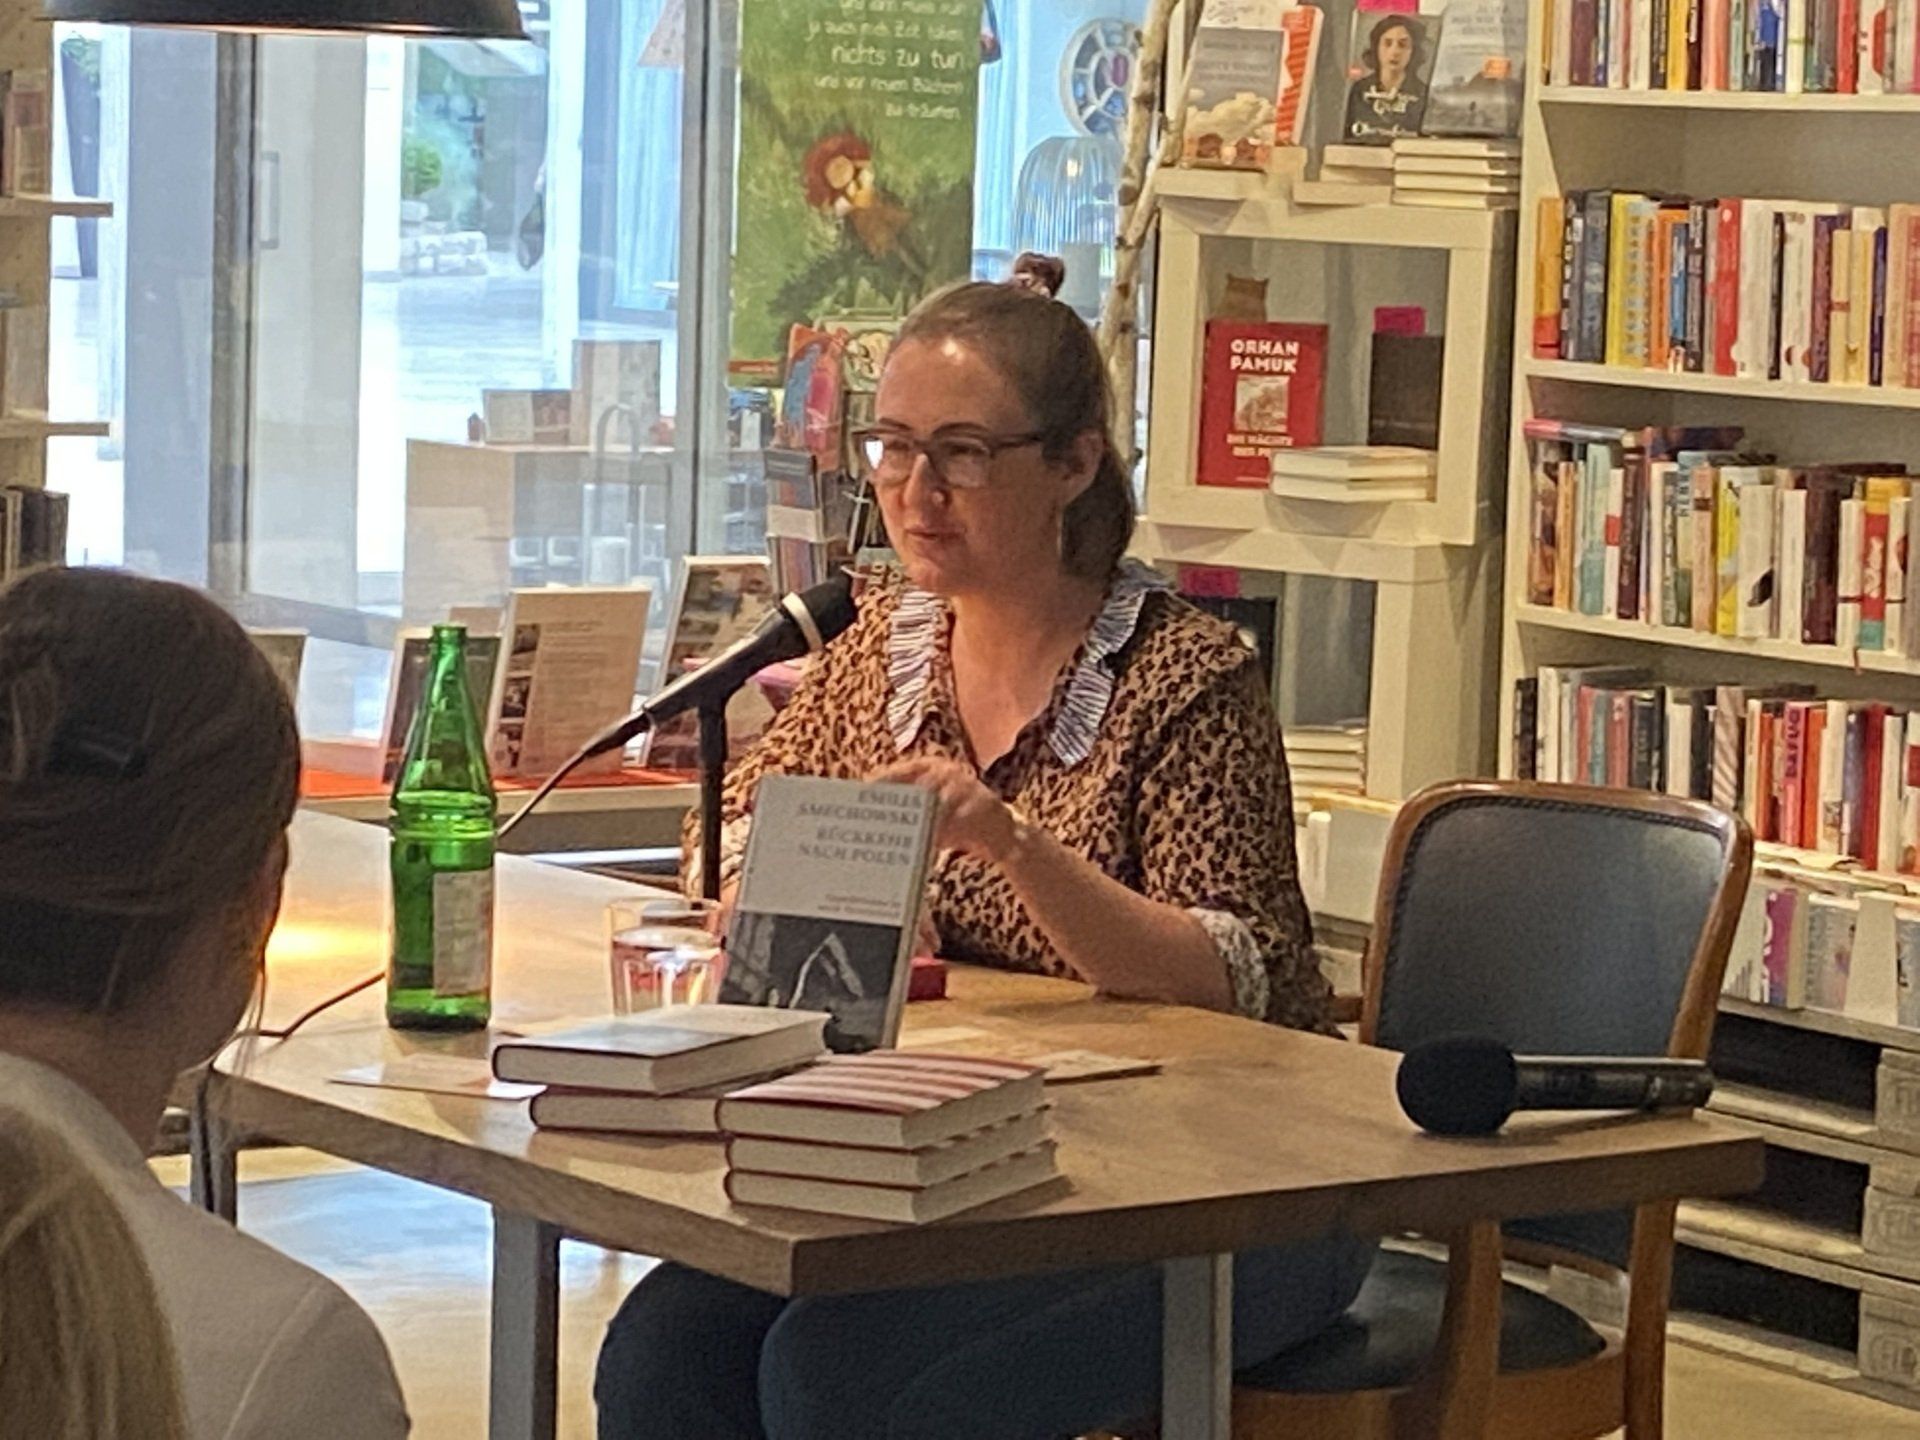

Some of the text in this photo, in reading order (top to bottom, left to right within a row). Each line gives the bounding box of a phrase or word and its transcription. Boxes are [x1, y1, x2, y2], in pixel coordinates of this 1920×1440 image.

[831, 40, 964, 70] nichts zu tun
[1230, 339, 1300, 356] ORHAN
[1229, 355, 1297, 374] PAMUK
[858, 789, 923, 809] EMILIA
[816, 825, 913, 849] RÜCKKEHR
[798, 843, 911, 866] NACH POLEN
